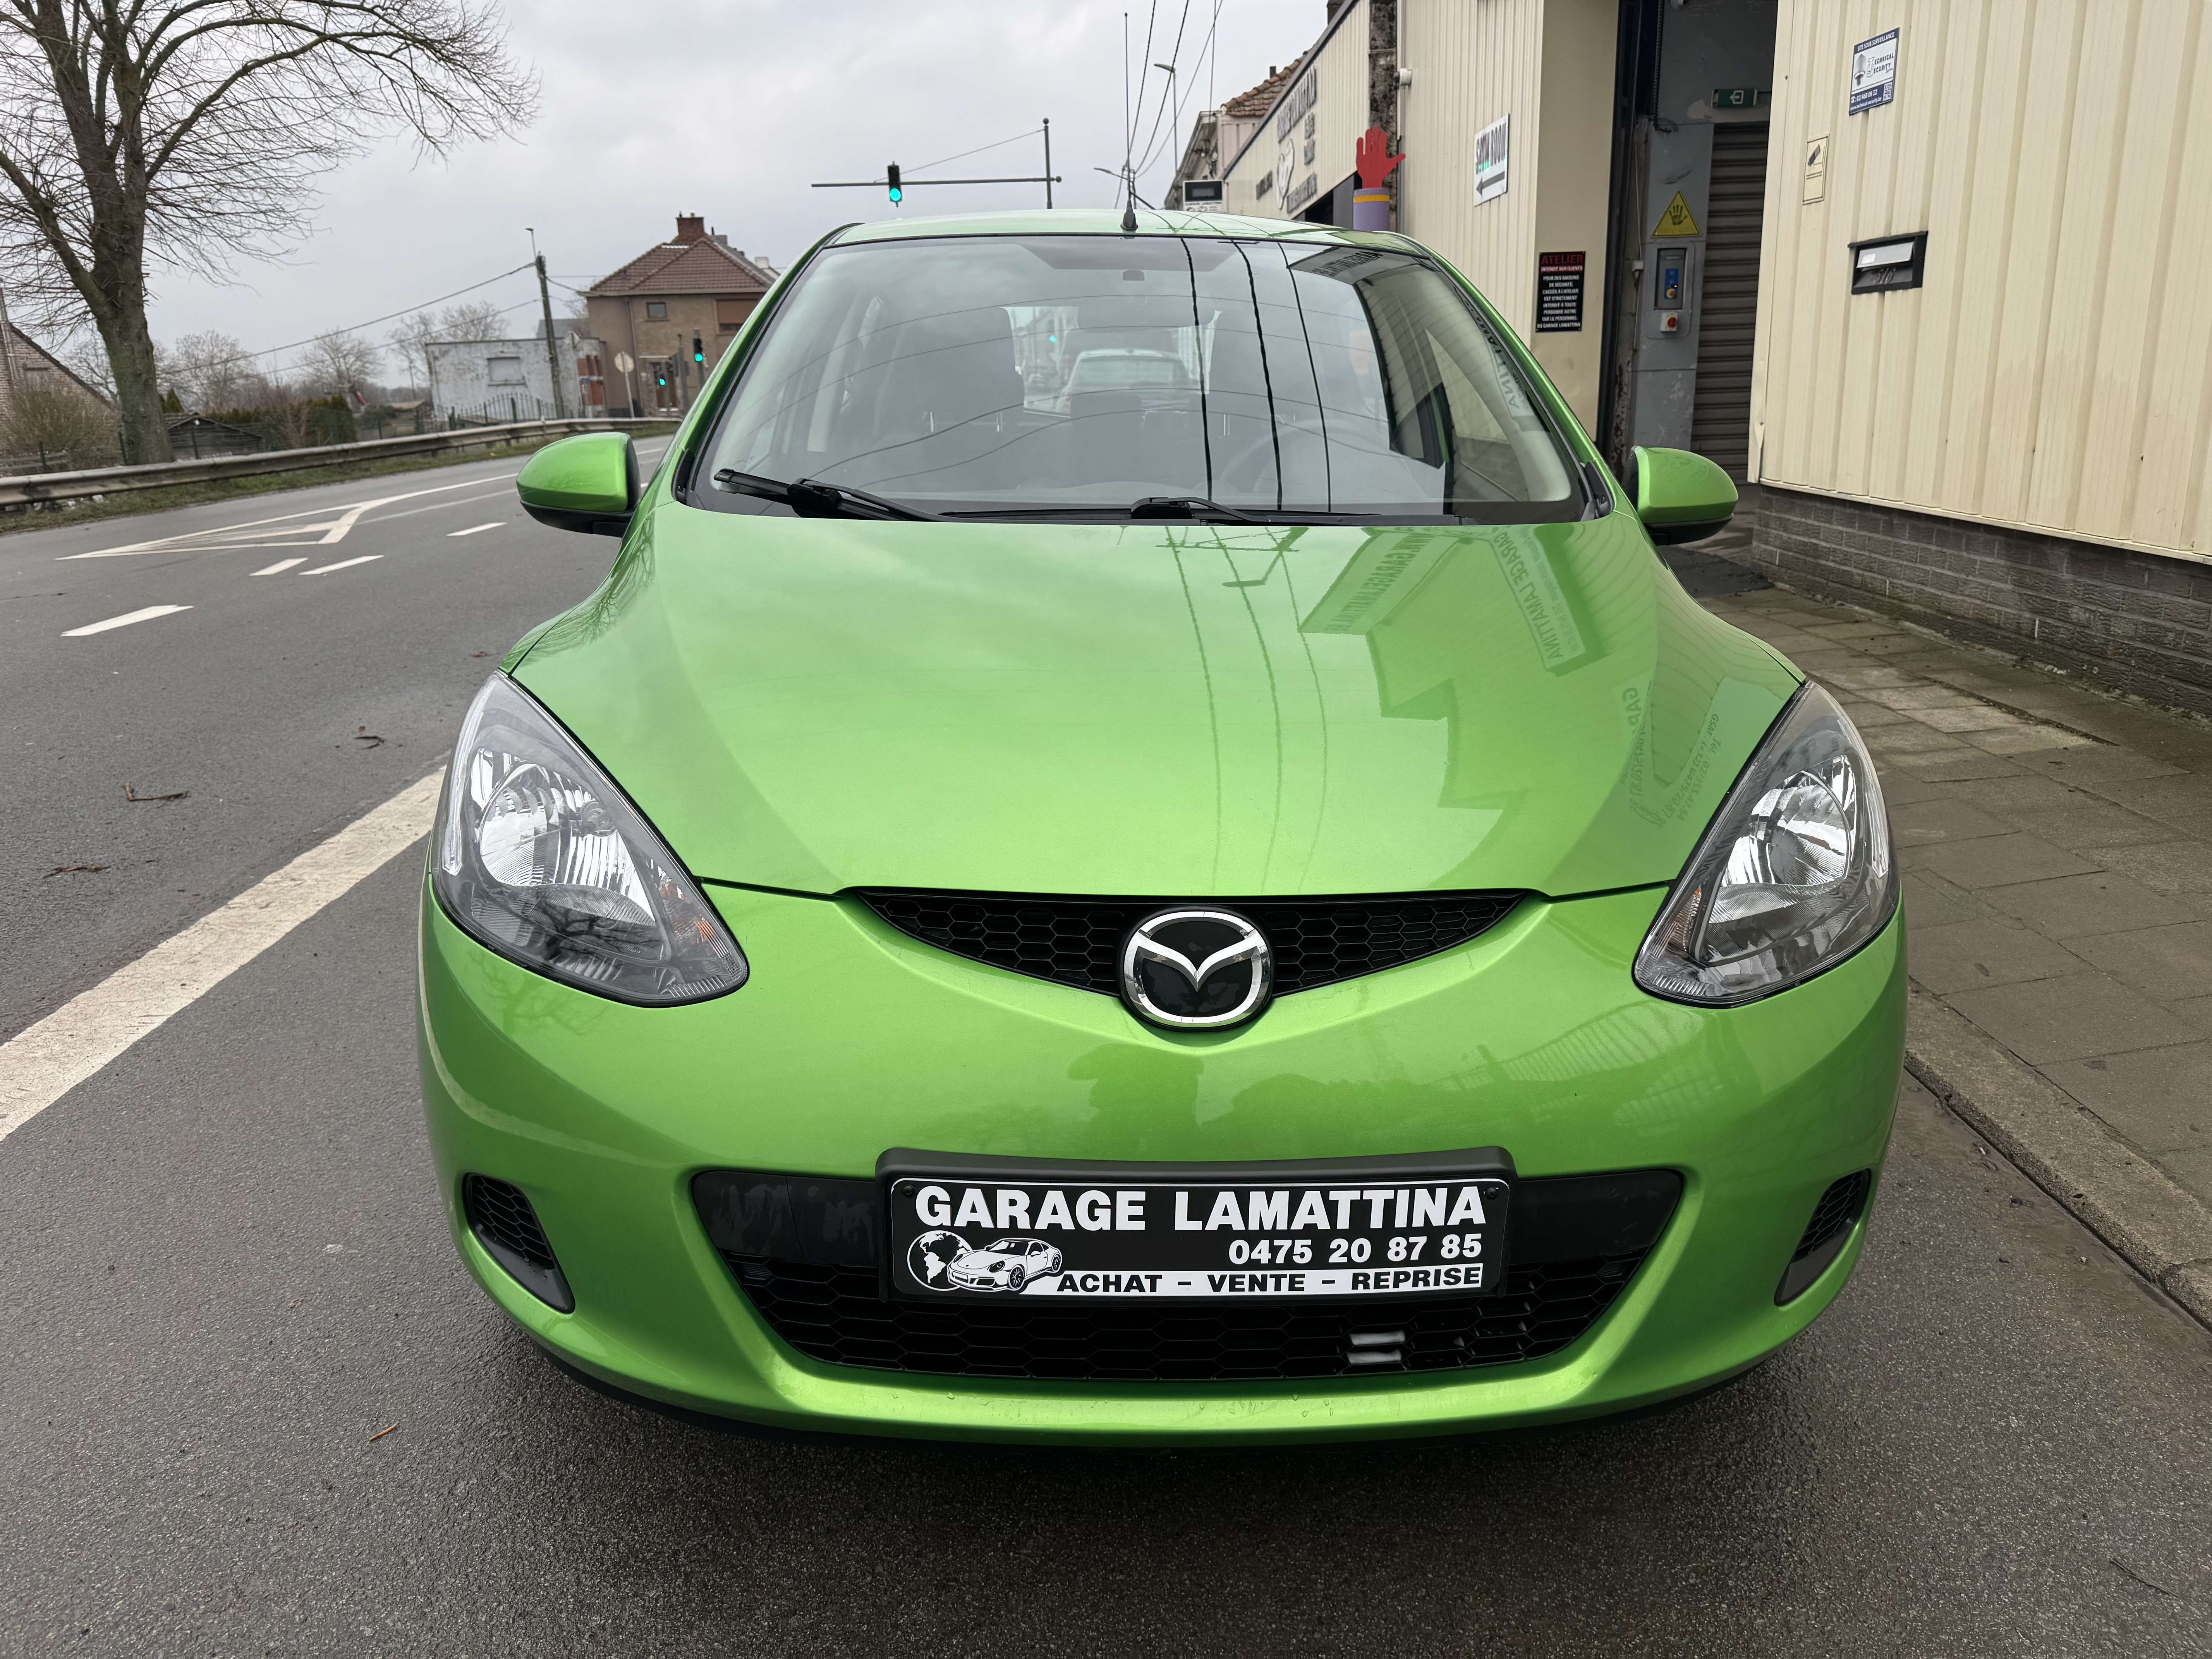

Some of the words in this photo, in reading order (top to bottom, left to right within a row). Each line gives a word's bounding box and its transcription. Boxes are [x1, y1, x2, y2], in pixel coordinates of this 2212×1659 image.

[1864, 40, 1872, 48] SOUS
[1872, 32, 1895, 45] SURVEILLANCE
[1541, 254, 1583, 264] ATELIER
[915, 1185, 1146, 1231] GARAGE
[1175, 1186, 1486, 1231] LAMATTINA
[1229, 1239, 1312, 1264] 0475
[1328, 1238, 1371, 1263] 20
[1387, 1236, 1427, 1262] 87
[1440, 1233, 1482, 1259] 85
[1056, 1274, 1162, 1293] ACHAT
[1207, 1273, 1305, 1292] VENTE
[1352, 1267, 1481, 1290] REPRISE
